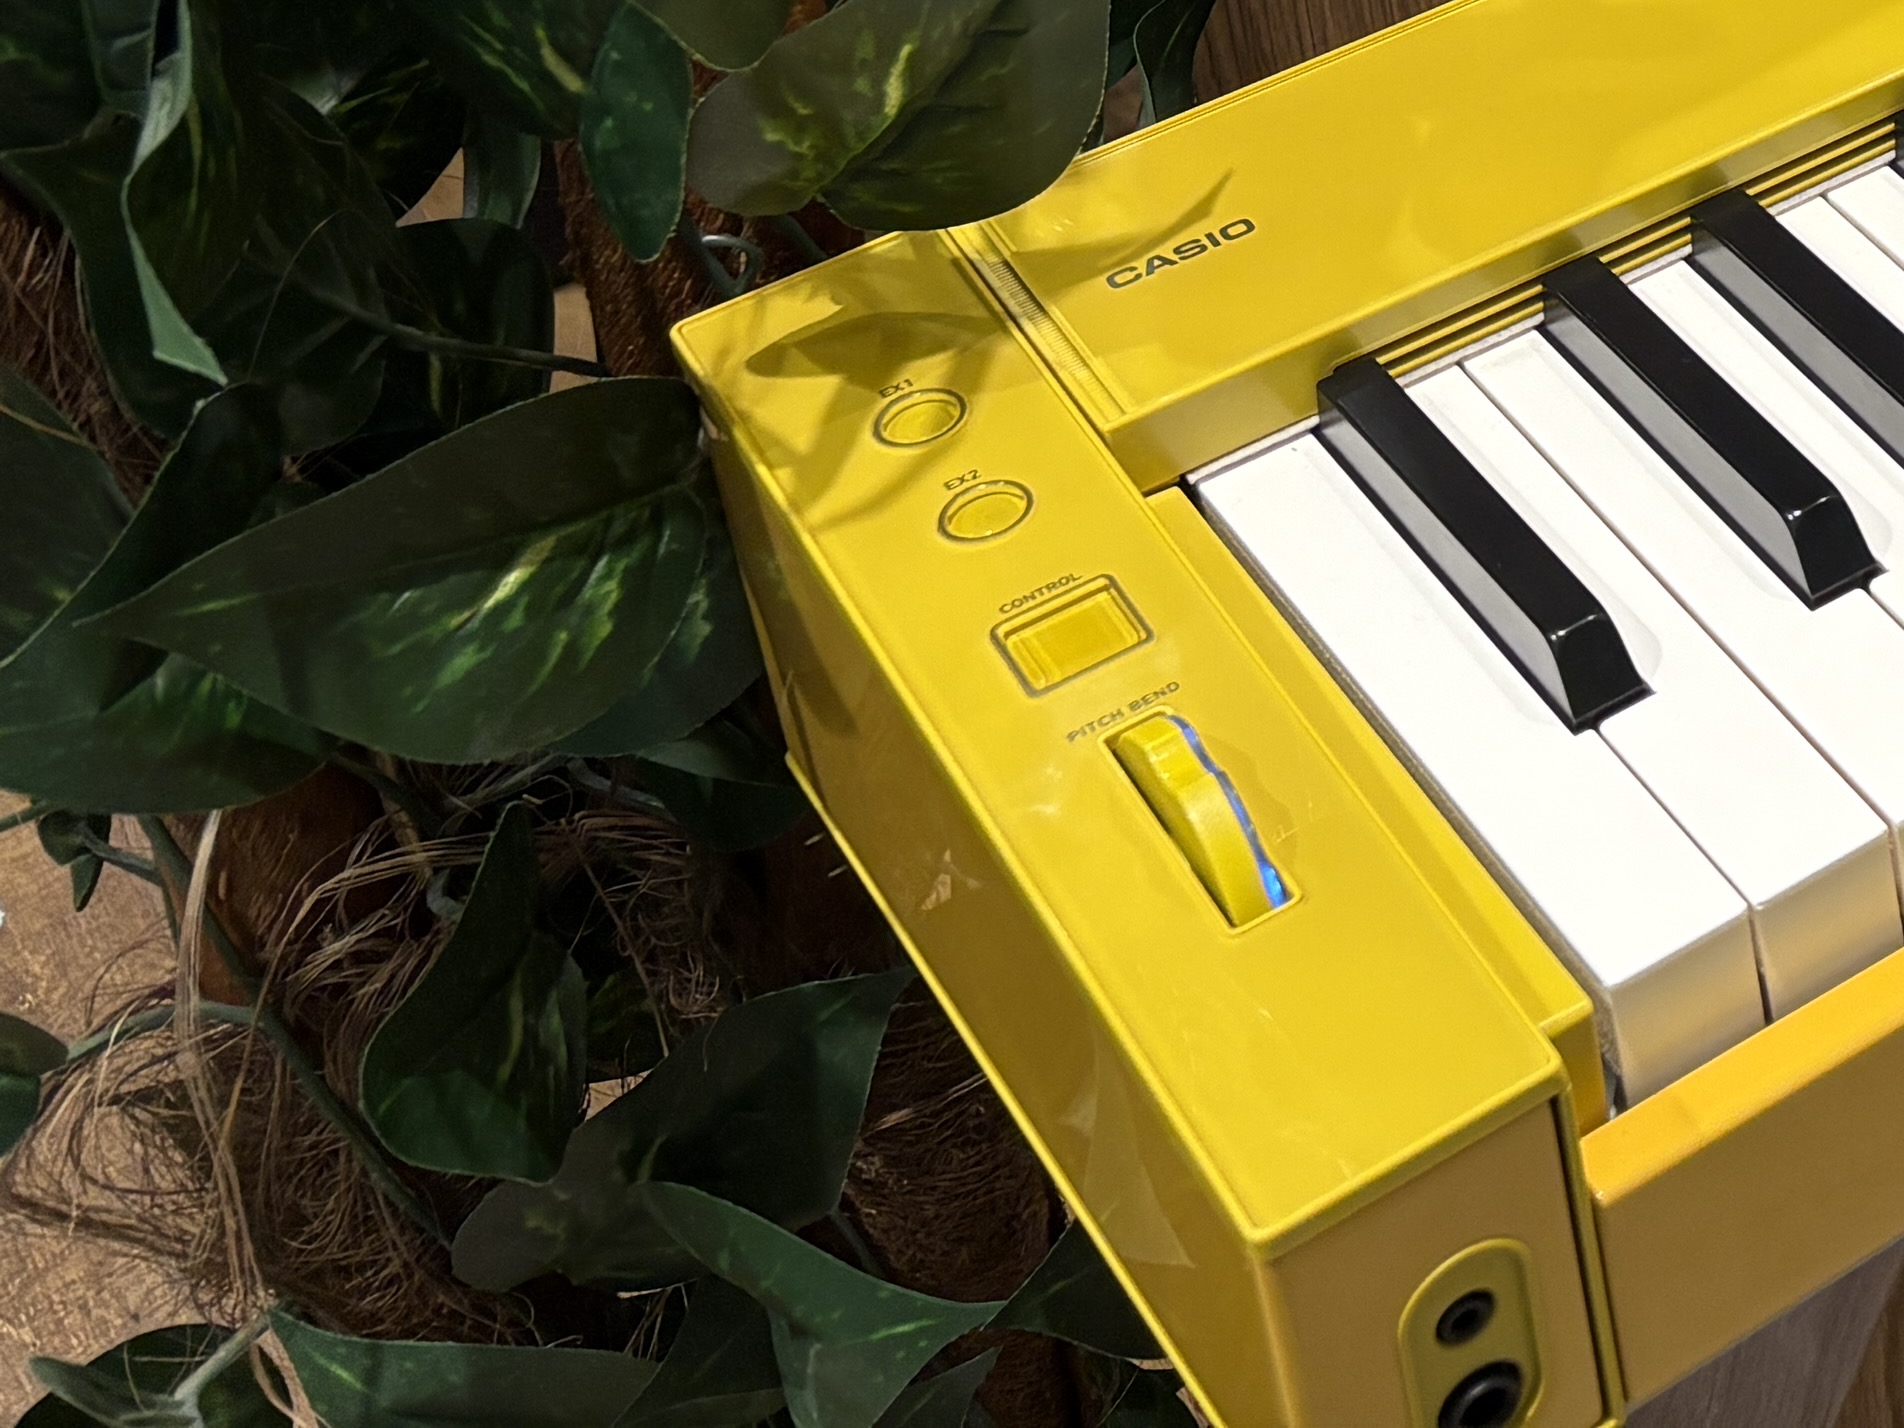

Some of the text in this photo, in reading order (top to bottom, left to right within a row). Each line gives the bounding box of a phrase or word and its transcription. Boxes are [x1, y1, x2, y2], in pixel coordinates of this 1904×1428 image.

[1105, 217, 1257, 289] CASIO
[878, 378, 915, 400] EX1
[943, 468, 982, 491] EX2
[998, 572, 1083, 615] CONTROL
[1066, 680, 1181, 744] PITCH BEND
